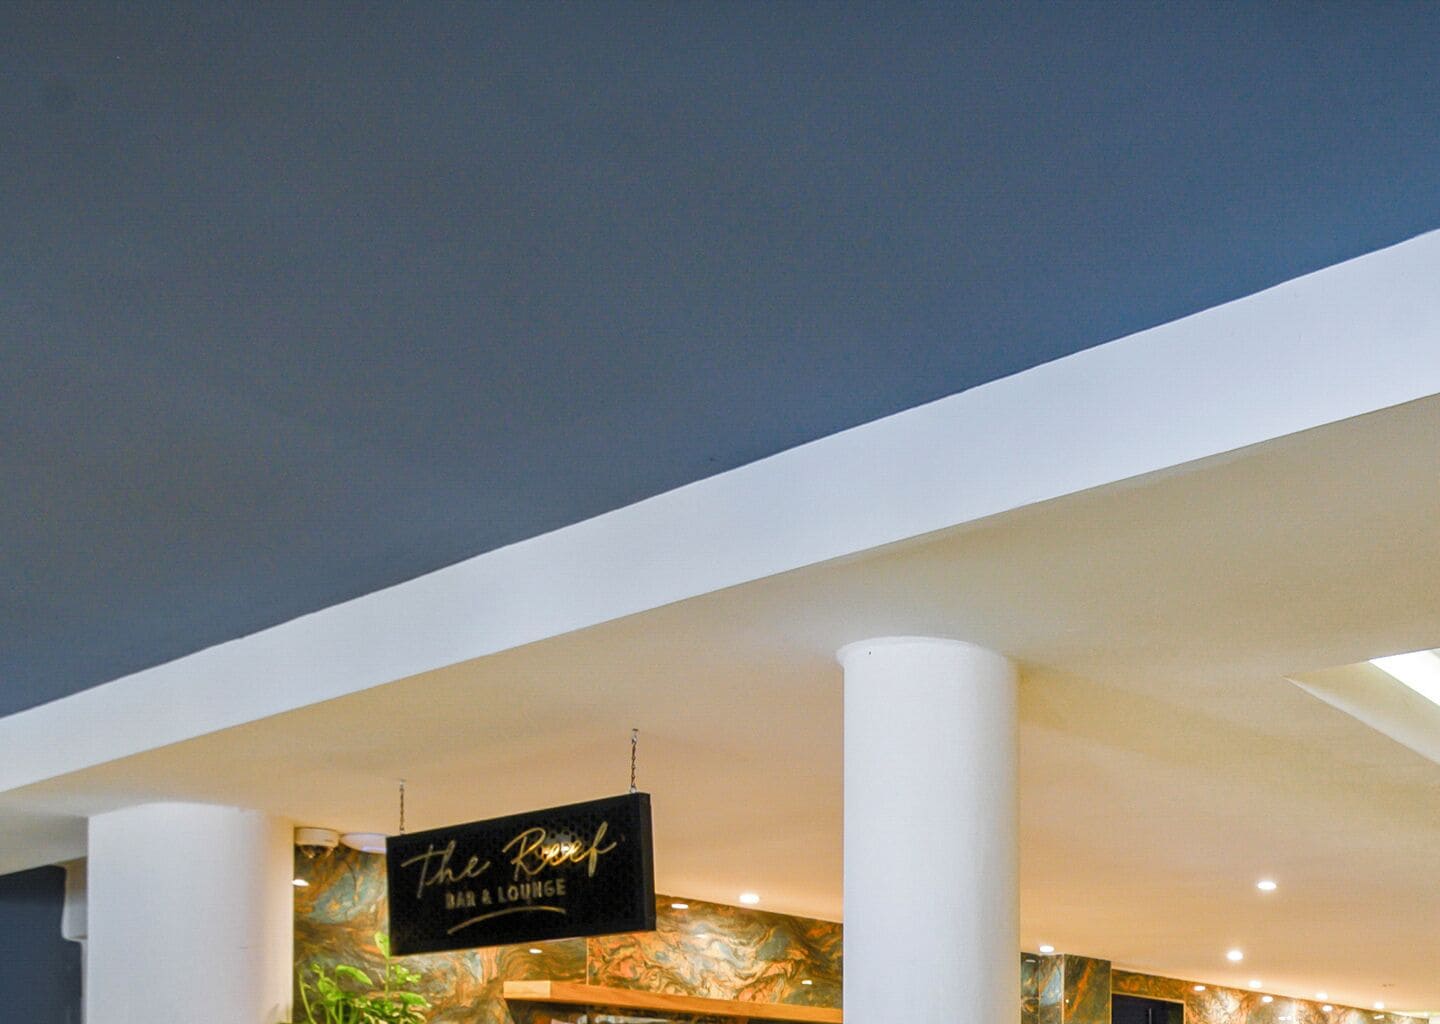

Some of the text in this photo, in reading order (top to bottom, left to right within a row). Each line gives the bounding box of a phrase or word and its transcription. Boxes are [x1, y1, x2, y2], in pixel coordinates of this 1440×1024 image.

[401, 820, 617, 899] The Reef
[446, 891, 476, 909] BAR
[498, 878, 567, 903] LOUNGE
